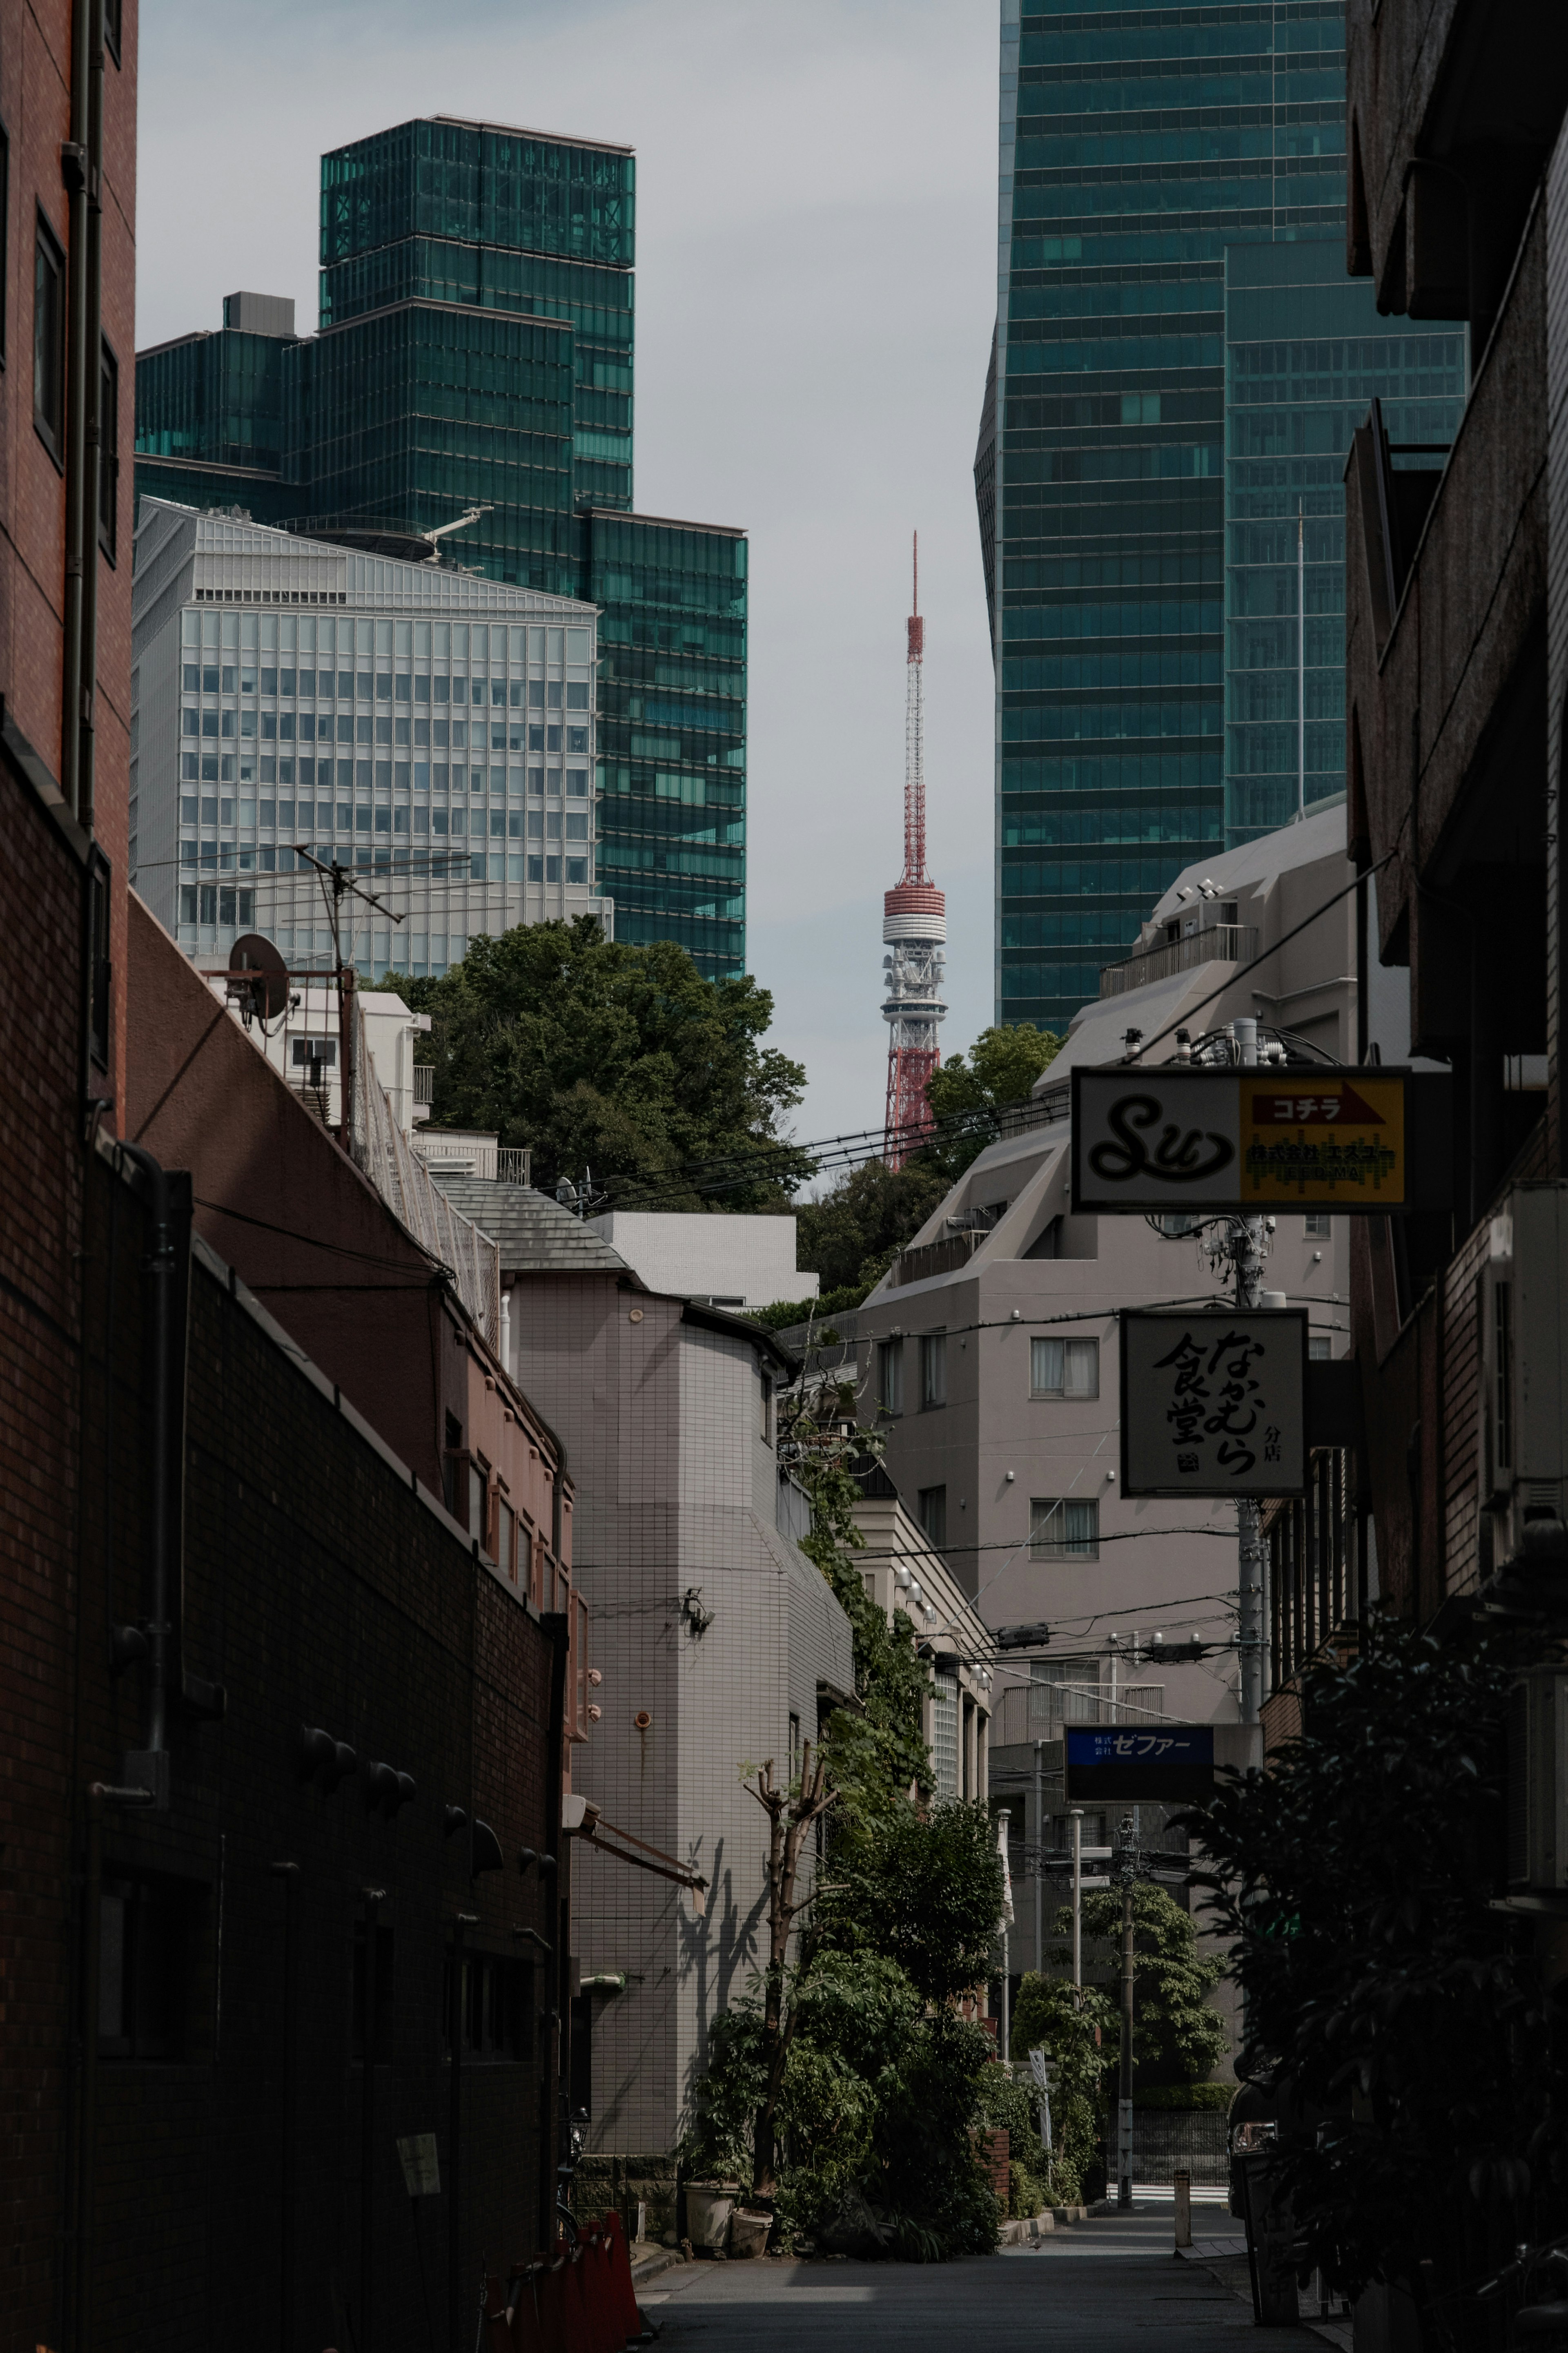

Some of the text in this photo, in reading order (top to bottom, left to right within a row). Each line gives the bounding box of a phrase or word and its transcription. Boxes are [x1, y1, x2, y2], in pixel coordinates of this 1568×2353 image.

[1274, 1098, 1341, 1120] コチラ
[1251, 1144, 1319, 1160] 株式会社
[1153, 1333, 1210, 1445] 食堂
[1204, 1331, 1265, 1475] なかむら
[1265, 1427, 1281, 1461] 分店
[1114, 1735, 1190, 1755] ゼファー
